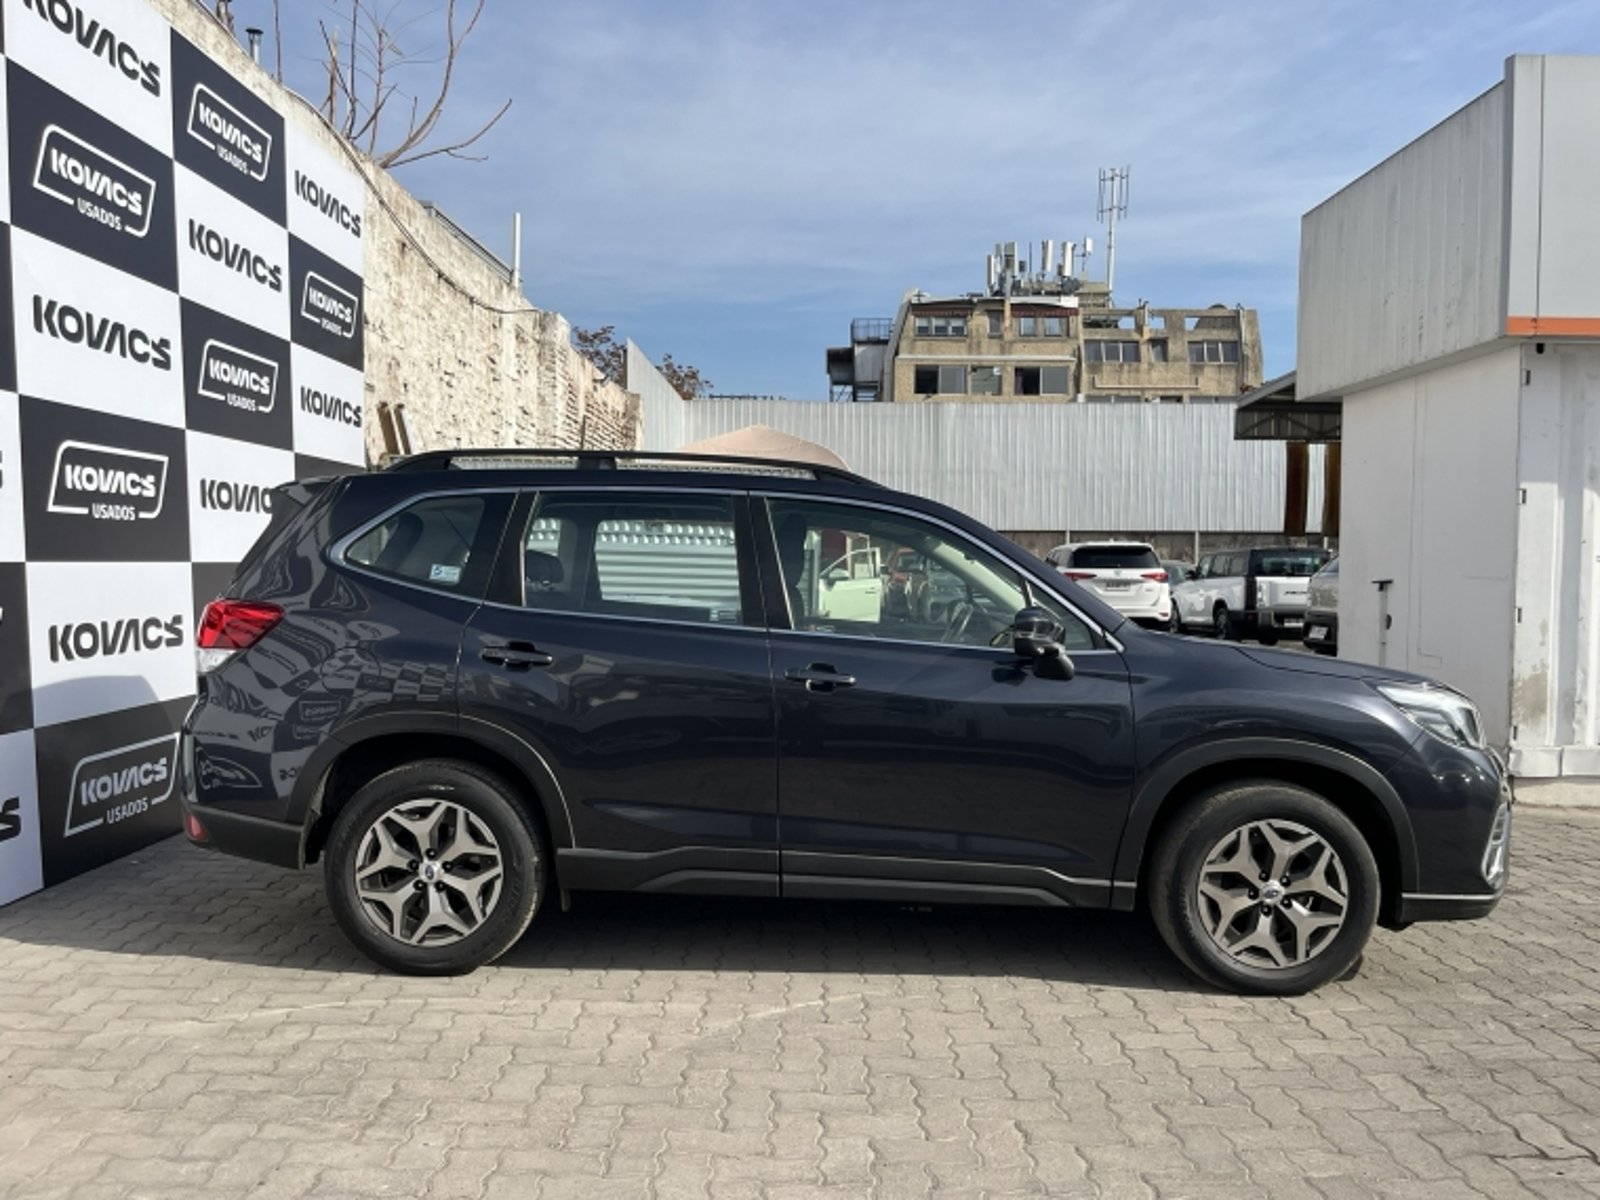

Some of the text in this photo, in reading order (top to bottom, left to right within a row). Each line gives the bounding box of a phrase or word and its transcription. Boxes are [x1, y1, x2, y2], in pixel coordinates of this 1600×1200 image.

[200, 103, 261, 163] KOVACS
[218, 146, 248, 173] USADOS
[52, 149, 142, 215] KOVACS
[78, 198, 121, 230] USADOS
[295, 170, 360, 238] KOVACS
[189, 219, 281, 292] KOVACS
[310, 288, 351, 322] KOVACS
[33, 295, 171, 370] KOVACS
[210, 359, 269, 394] KOVACS
[227, 393, 256, 411] USADOS
[301, 387, 361, 427] KOVACS
[65, 465, 155, 497] KOVACS
[200, 479, 272, 514] KOVAC
[93, 504, 135, 520] USADOS
[49, 615, 183, 662] KOVACS
[81, 756, 168, 805] KOVACS
[107, 797, 148, 823] USADOS
